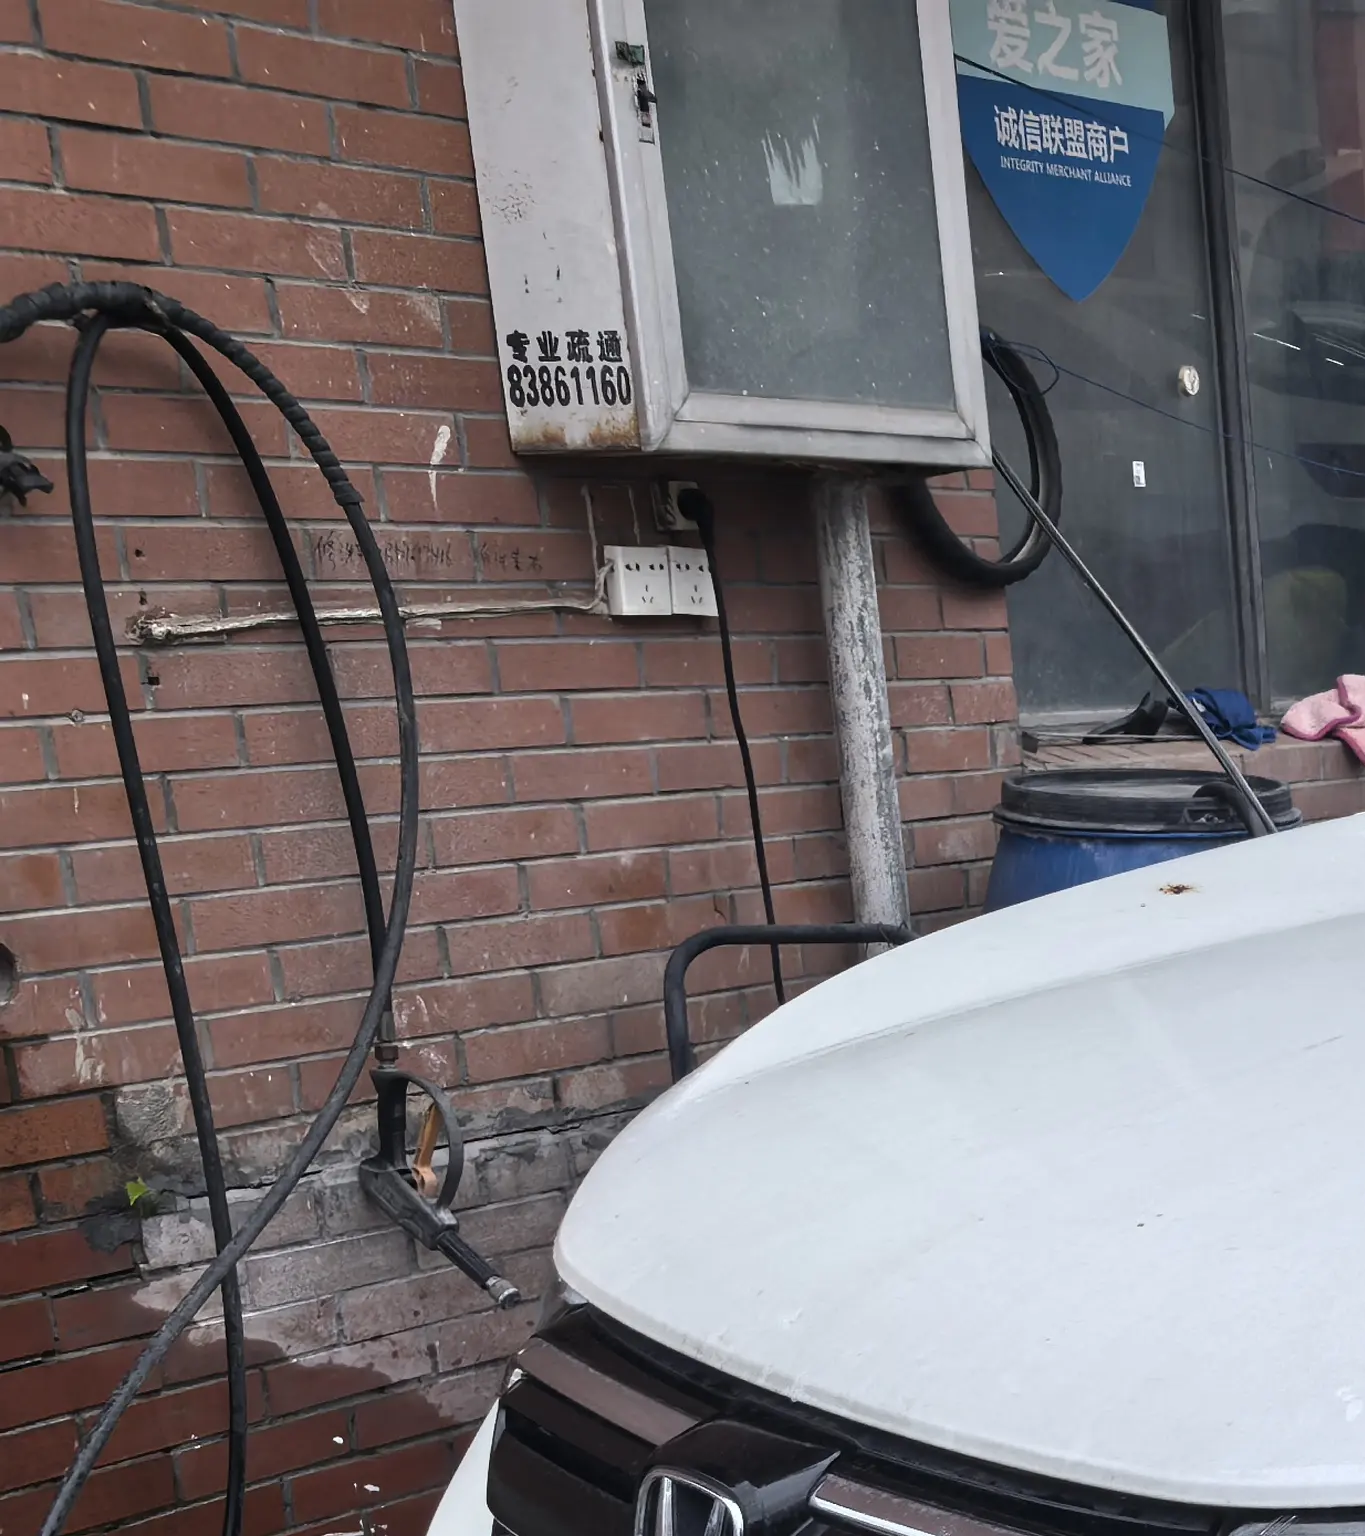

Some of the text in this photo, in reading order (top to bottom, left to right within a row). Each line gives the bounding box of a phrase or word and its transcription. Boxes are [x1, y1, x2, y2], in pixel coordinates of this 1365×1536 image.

[987, 0, 1122, 88] 爱之家
[993, 104, 1129, 164] 诚信联盟商户
[1000, 155, 1132, 187] INTEGRITY MERCHANT ALLIANCE
[506, 329, 623, 363] 专业疏通
[507, 364, 632, 408] 83861160
